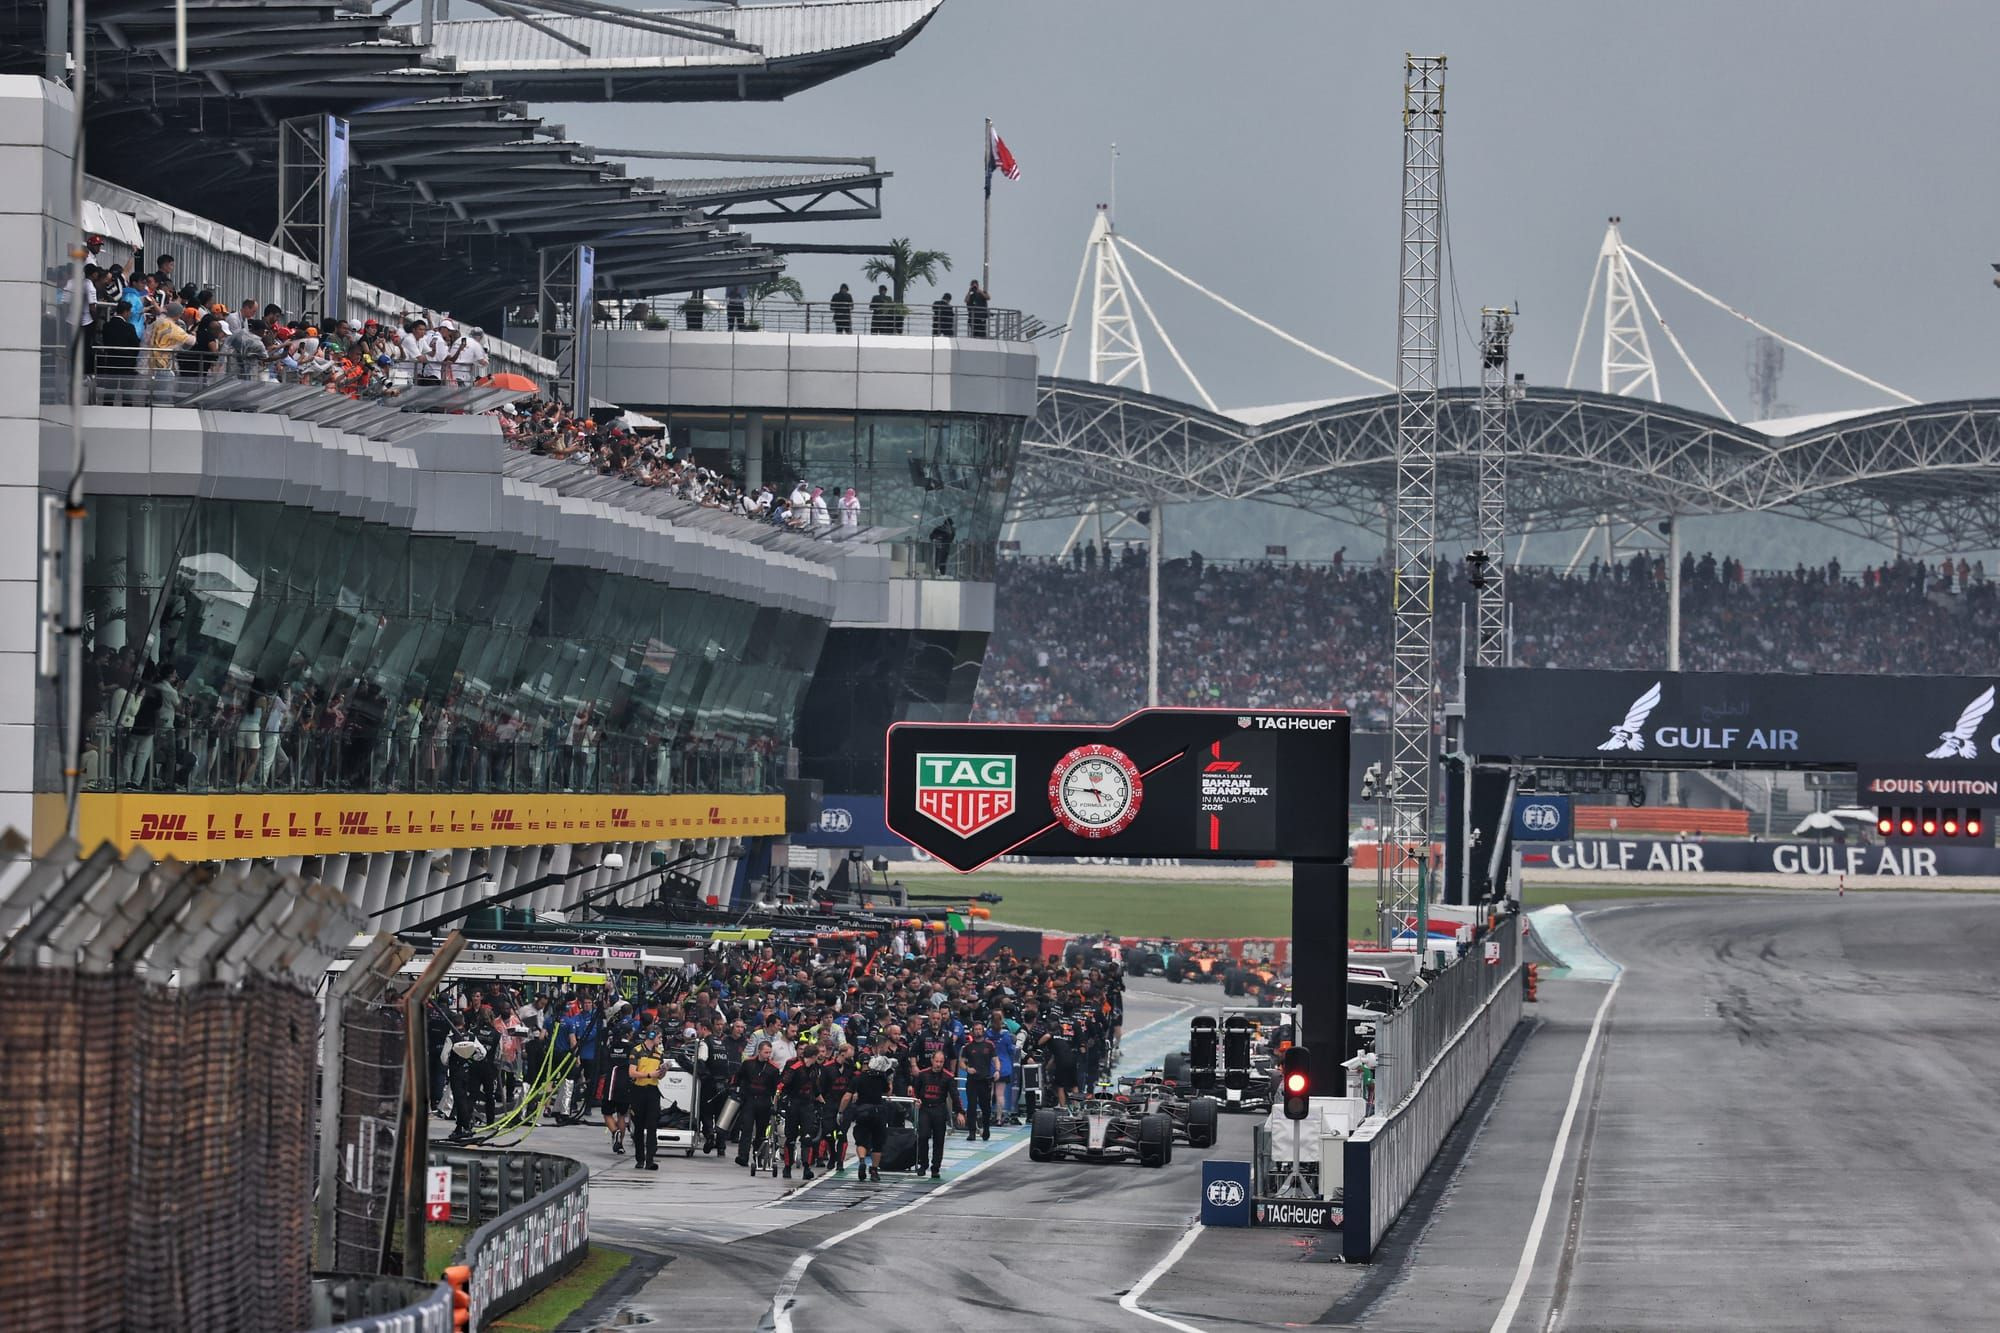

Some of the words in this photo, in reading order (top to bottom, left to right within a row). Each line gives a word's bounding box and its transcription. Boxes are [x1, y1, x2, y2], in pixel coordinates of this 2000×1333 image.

[1655, 726, 1740, 748] GULF
[1746, 728, 1799, 750] AIR
[1069, 750, 1081, 759] 55
[1112, 750, 1124, 759] 05
[925, 760, 1006, 785] TAG
[1129, 766, 1138, 776] 10
[1202, 779, 1251, 787] BAHRAIN
[1875, 779, 1924, 793] LOUIS
[1927, 780, 1998, 794] VUITTON
[1135, 788, 1143, 797] 15
[1202, 787, 1241, 795] GRAND
[1242, 787, 1269, 796] PRIX
[923, 792, 1009, 831] HEUER
[1128, 808, 1138, 820] 20
[140, 814, 188, 840] DHL
[1551, 841, 1637, 870] GULF
[1647, 842, 1704, 872] AIR
[1773, 845, 1866, 875] GULF
[1876, 847, 1938, 876] AIR
